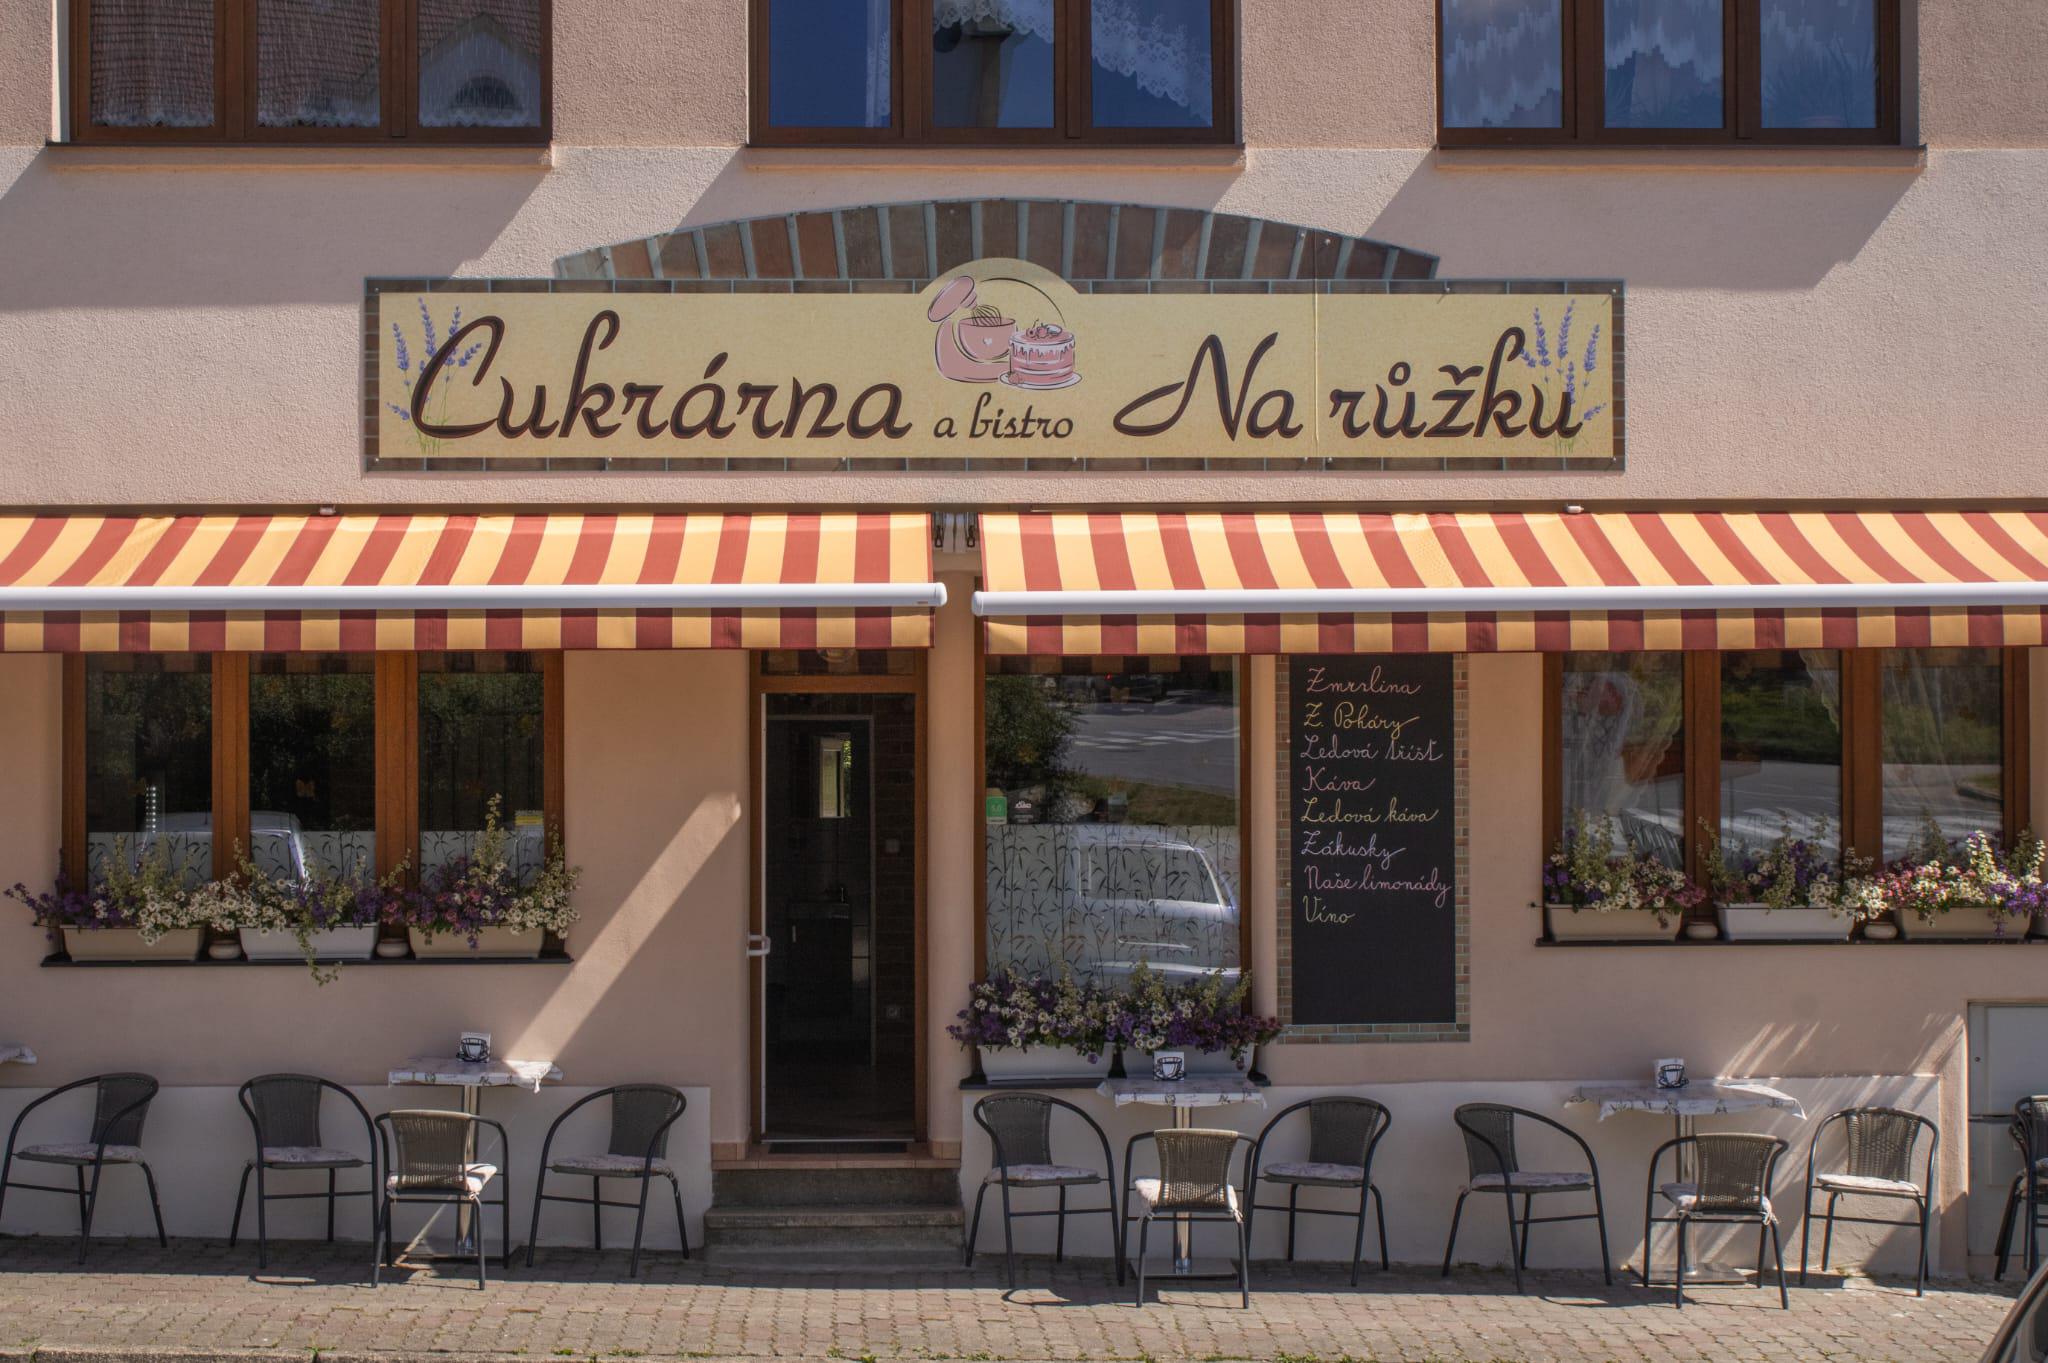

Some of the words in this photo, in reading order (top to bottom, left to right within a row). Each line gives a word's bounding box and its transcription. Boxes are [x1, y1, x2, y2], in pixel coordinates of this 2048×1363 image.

[410, 310, 912, 439] Cukrárna
[933, 417, 957, 438] a
[969, 391, 1074, 439] bistro
[1112, 332, 1304, 442] Na
[1328, 326, 1584, 439] růžku
[1334, 701, 1420, 740] Poháry
[1300, 734, 1379, 759] Ledová
[1303, 765, 1376, 791] Káva
[1300, 797, 1382, 823] Ledová
[1384, 797, 1439, 822] káva
[1301, 830, 1407, 870] Zákusky
[1304, 865, 1358, 889] Naše
[1358, 864, 1452, 908] limonády
[1303, 896, 1356, 923] Víno
